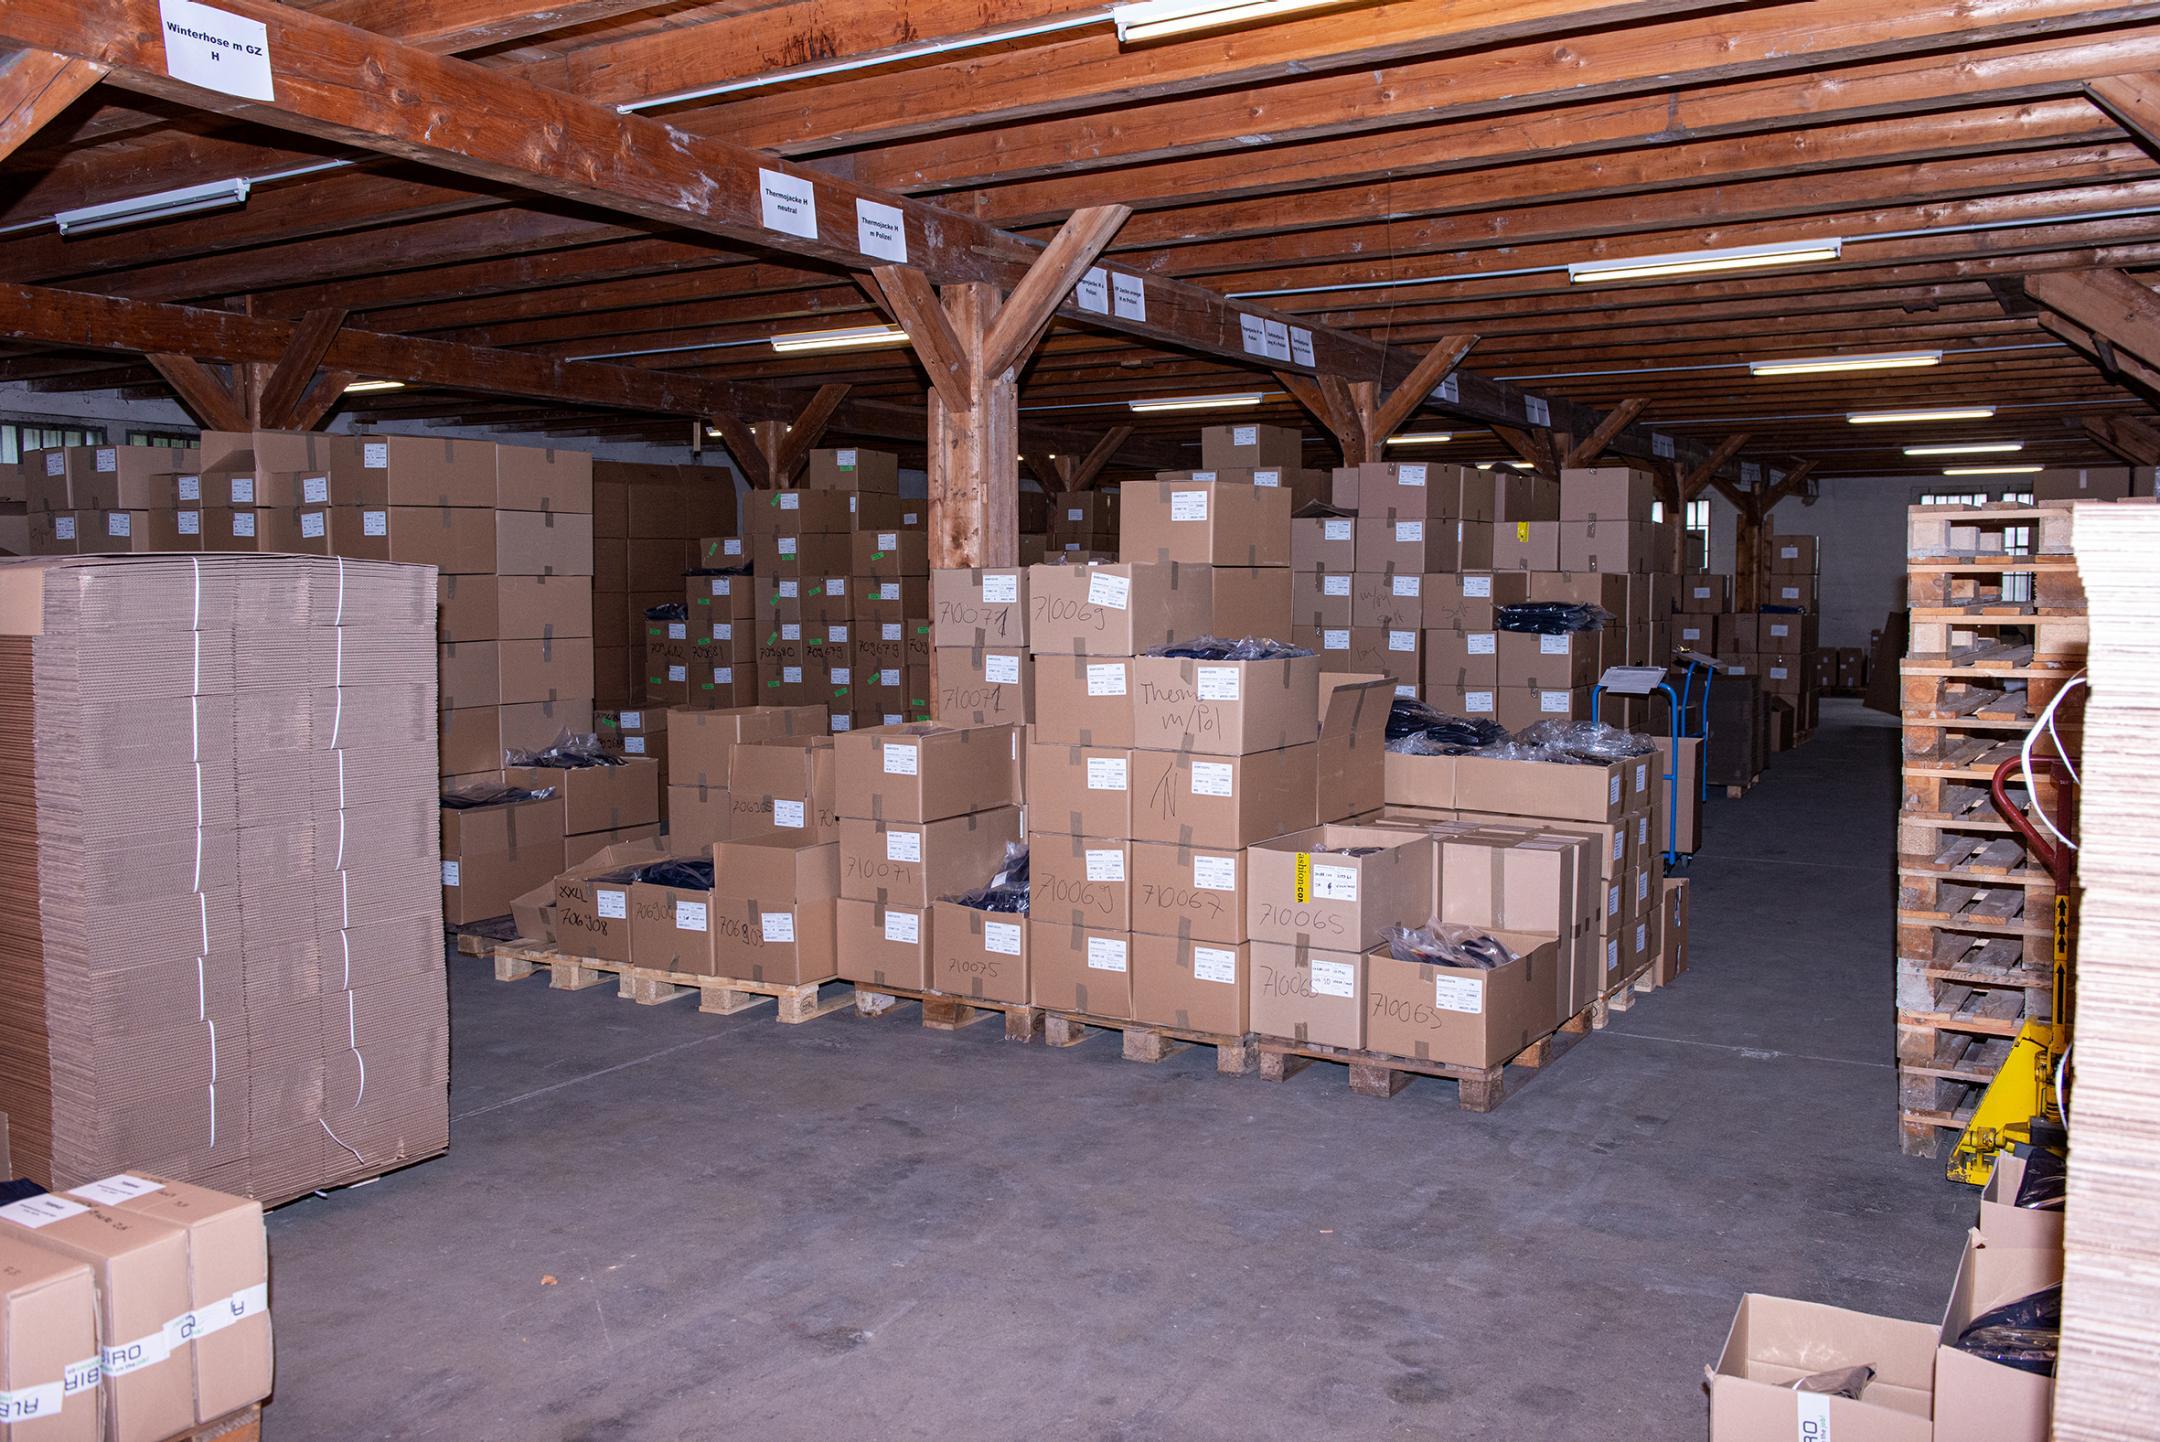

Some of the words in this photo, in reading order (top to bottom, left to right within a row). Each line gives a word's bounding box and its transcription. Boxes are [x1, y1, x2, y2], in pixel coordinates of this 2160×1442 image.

[166, 21, 230, 48] Winterhose
[233, 43, 243, 52] m
[246, 44, 263, 56] GZ
[211, 51, 220, 61] H
[765, 187, 803, 205] Thermojacke
[777, 204, 798, 215] neutral
[875, 231, 892, 241] Polizei
[847, 856, 911, 884] 710071
